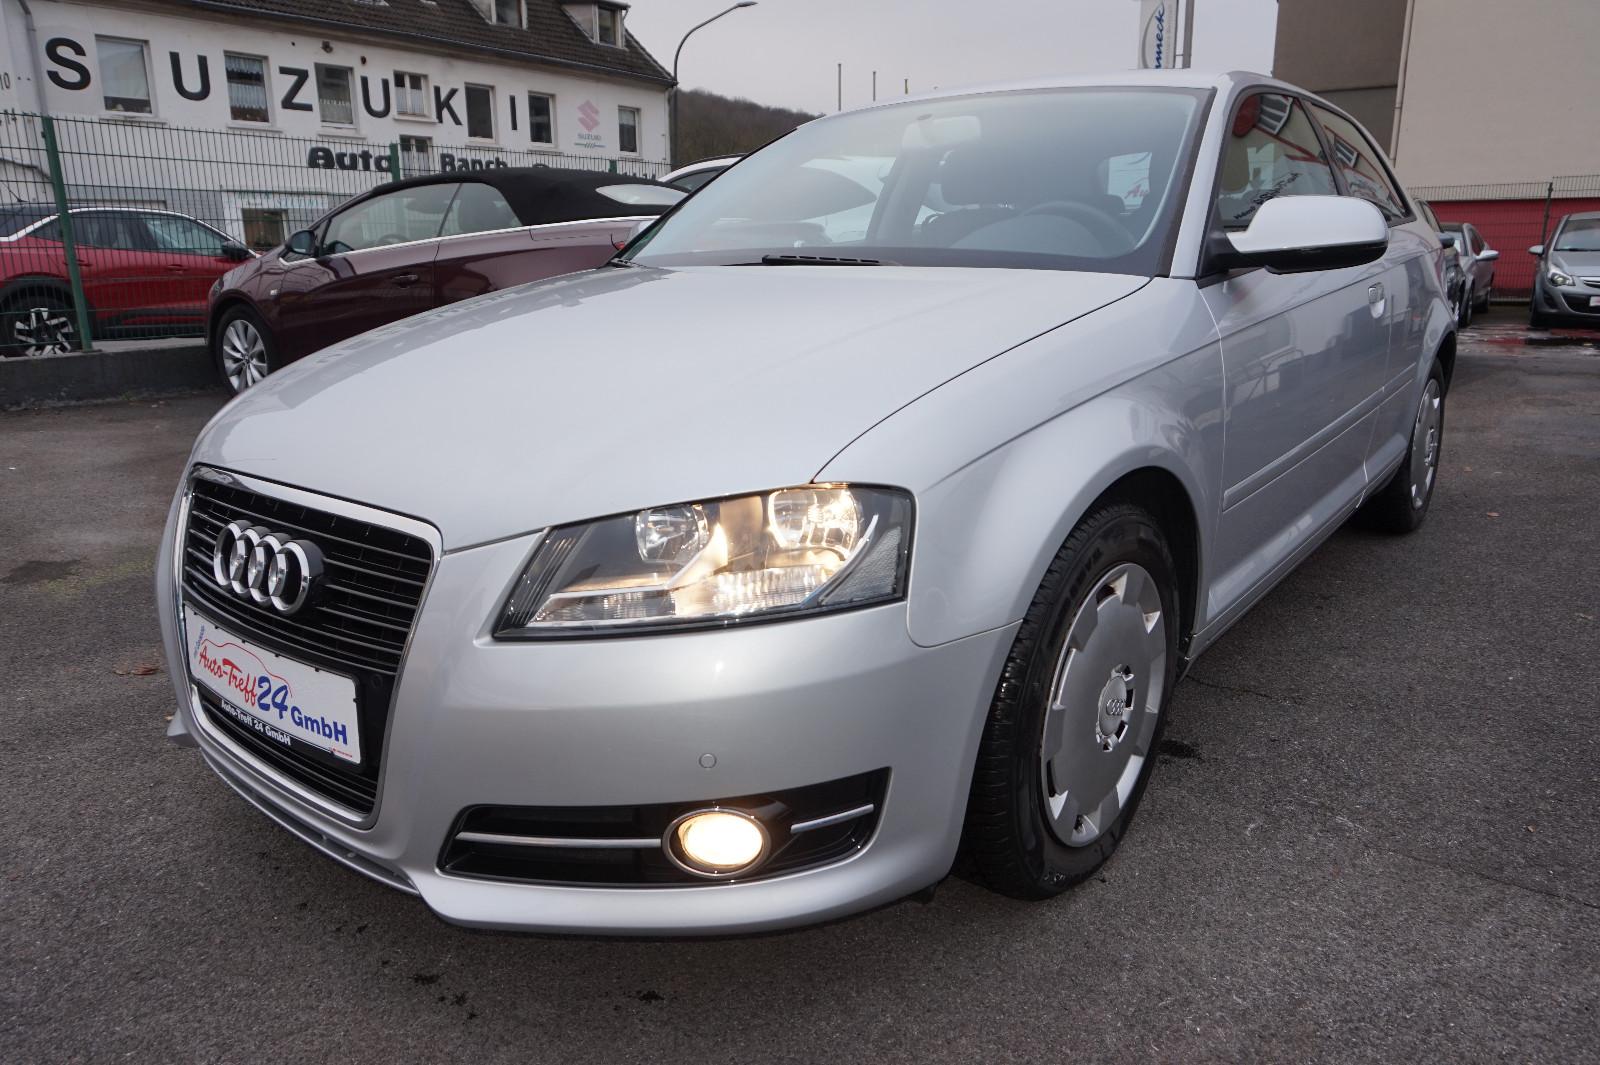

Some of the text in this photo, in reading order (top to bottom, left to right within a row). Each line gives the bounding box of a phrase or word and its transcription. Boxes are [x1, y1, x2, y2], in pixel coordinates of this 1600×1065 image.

[45, 37, 518, 131] SUZUKI
[253, 719, 264, 733] 24
[264, 725, 291, 746] GmbH
[290, 706, 348, 745] GmbH
